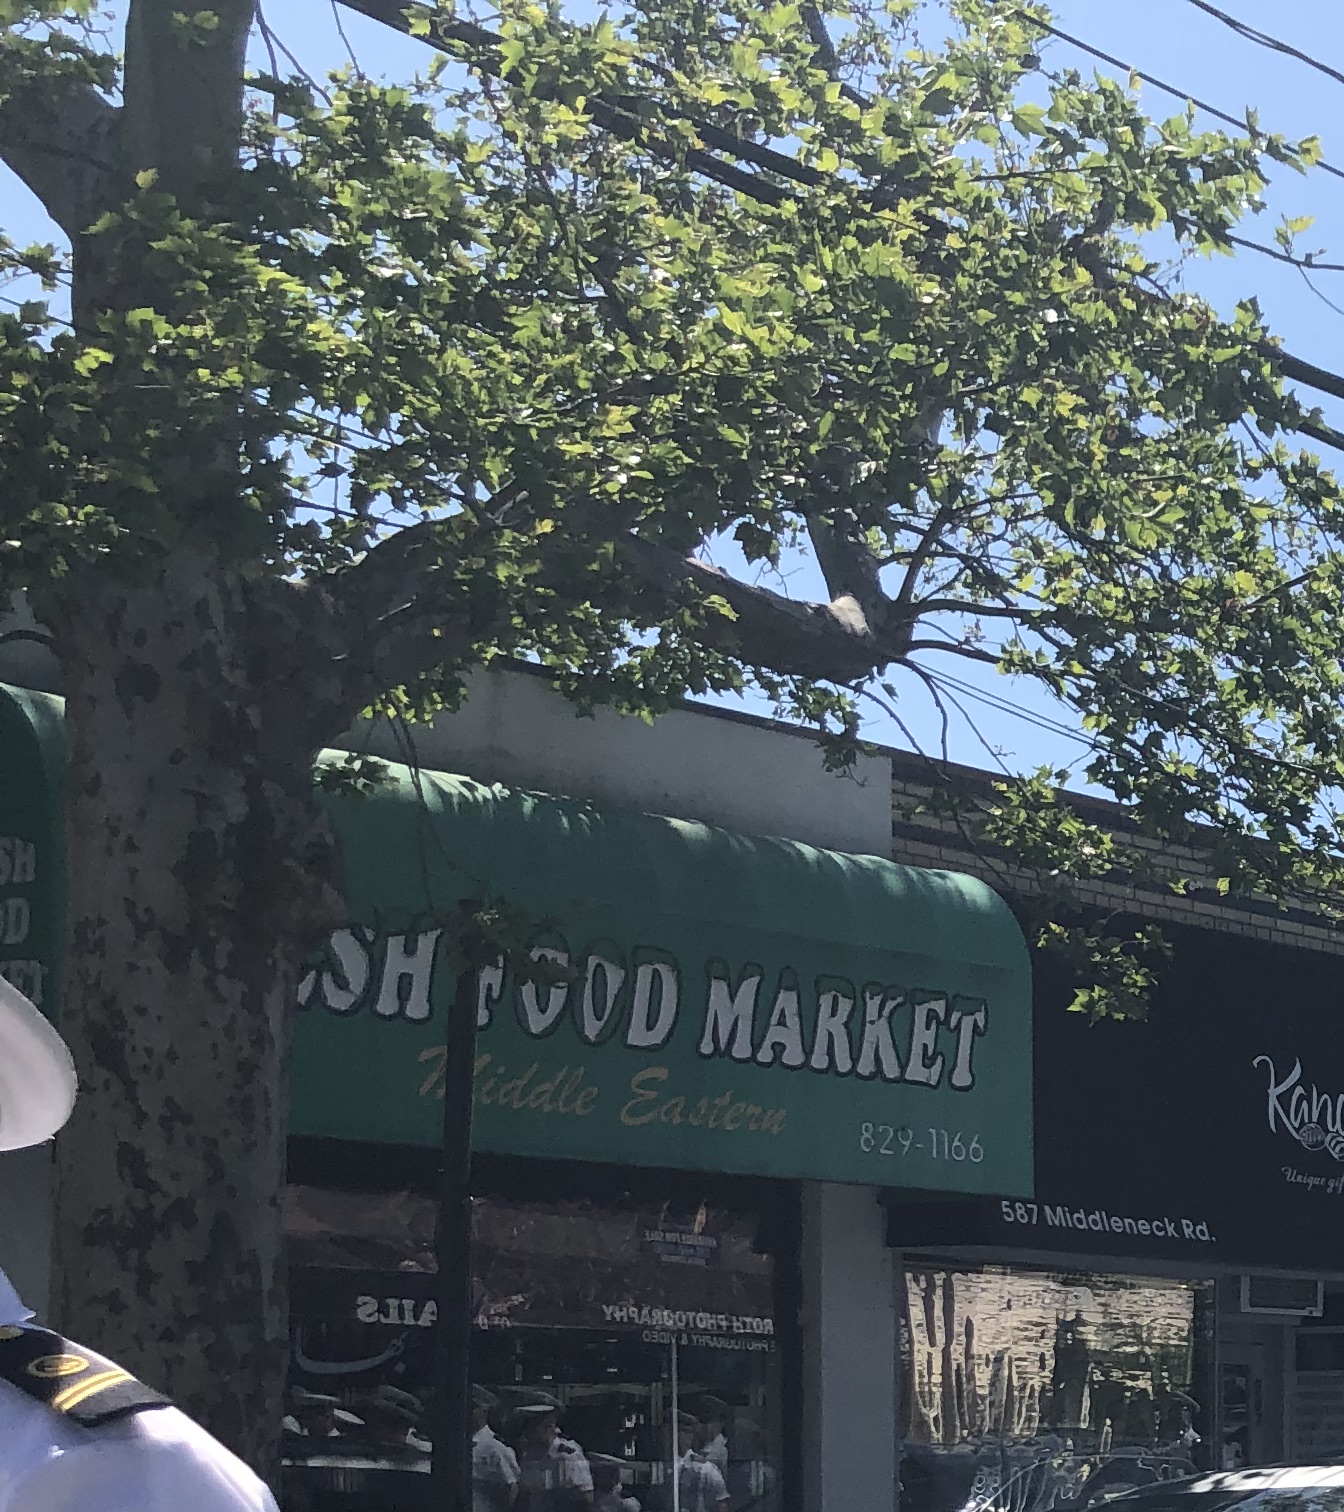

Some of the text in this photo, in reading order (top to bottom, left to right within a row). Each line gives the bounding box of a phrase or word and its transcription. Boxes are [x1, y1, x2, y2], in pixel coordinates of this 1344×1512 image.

[0, 897, 31, 944] D
[297, 926, 443, 1020] SH
[700, 975, 987, 1089] MARKET
[619, 1067, 787, 1135] Eastern
[859, 1121, 985, 1164] 829-1166
[1281, 1166, 1326, 1188] Unique
[1001, 1200, 1217, 1242] 587 Middleneck Rd.
